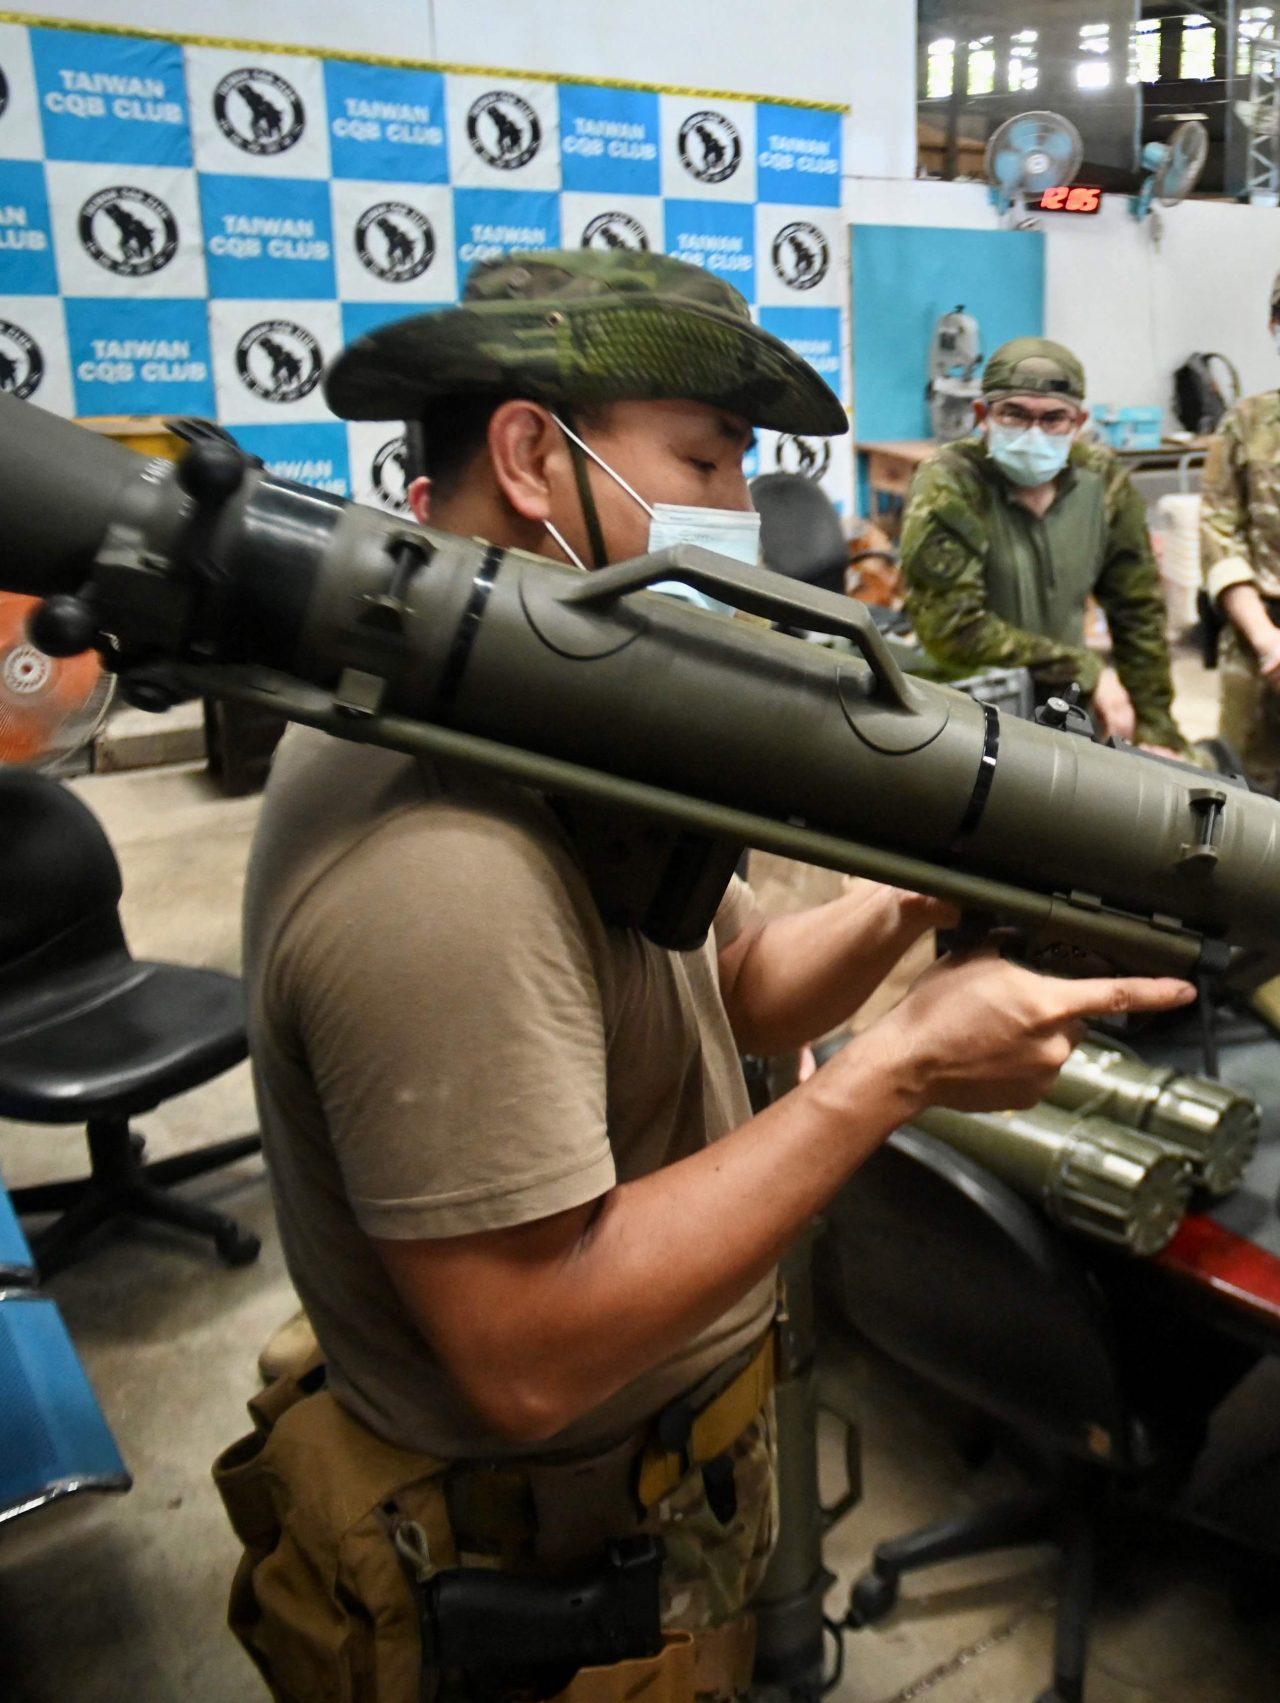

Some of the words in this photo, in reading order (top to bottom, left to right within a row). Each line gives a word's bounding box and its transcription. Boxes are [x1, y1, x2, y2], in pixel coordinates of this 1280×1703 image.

[59, 69, 165, 98] TAIWAN
[45, 91, 106, 118] CQB
[111, 98, 183, 124] CLUB
[344, 98, 430, 124] TAIWAN
[332, 118, 381, 142] CQB
[385, 122, 443, 146] CLUB
[573, 117, 645, 140] TAIWAN
[562, 135, 604, 157] CQB
[607, 140, 657, 160] CLUB
[768, 134, 830, 156] TAIWAN
[759, 151, 794, 171] CQB
[796, 156, 838, 174] CLUB
[222, 214, 314, 238] TAIWAN
[471, 224, 546, 245] TAIWAN
[209, 235, 262, 258] CQB
[267, 239, 329, 260] CLUB
[677, 233, 743, 253] TAIWAN
[707, 253, 752, 272] CLUB
[91, 339, 190, 360] TAIWAN
[78, 361, 135, 384] CQB
[141, 361, 206, 382] CLUB
